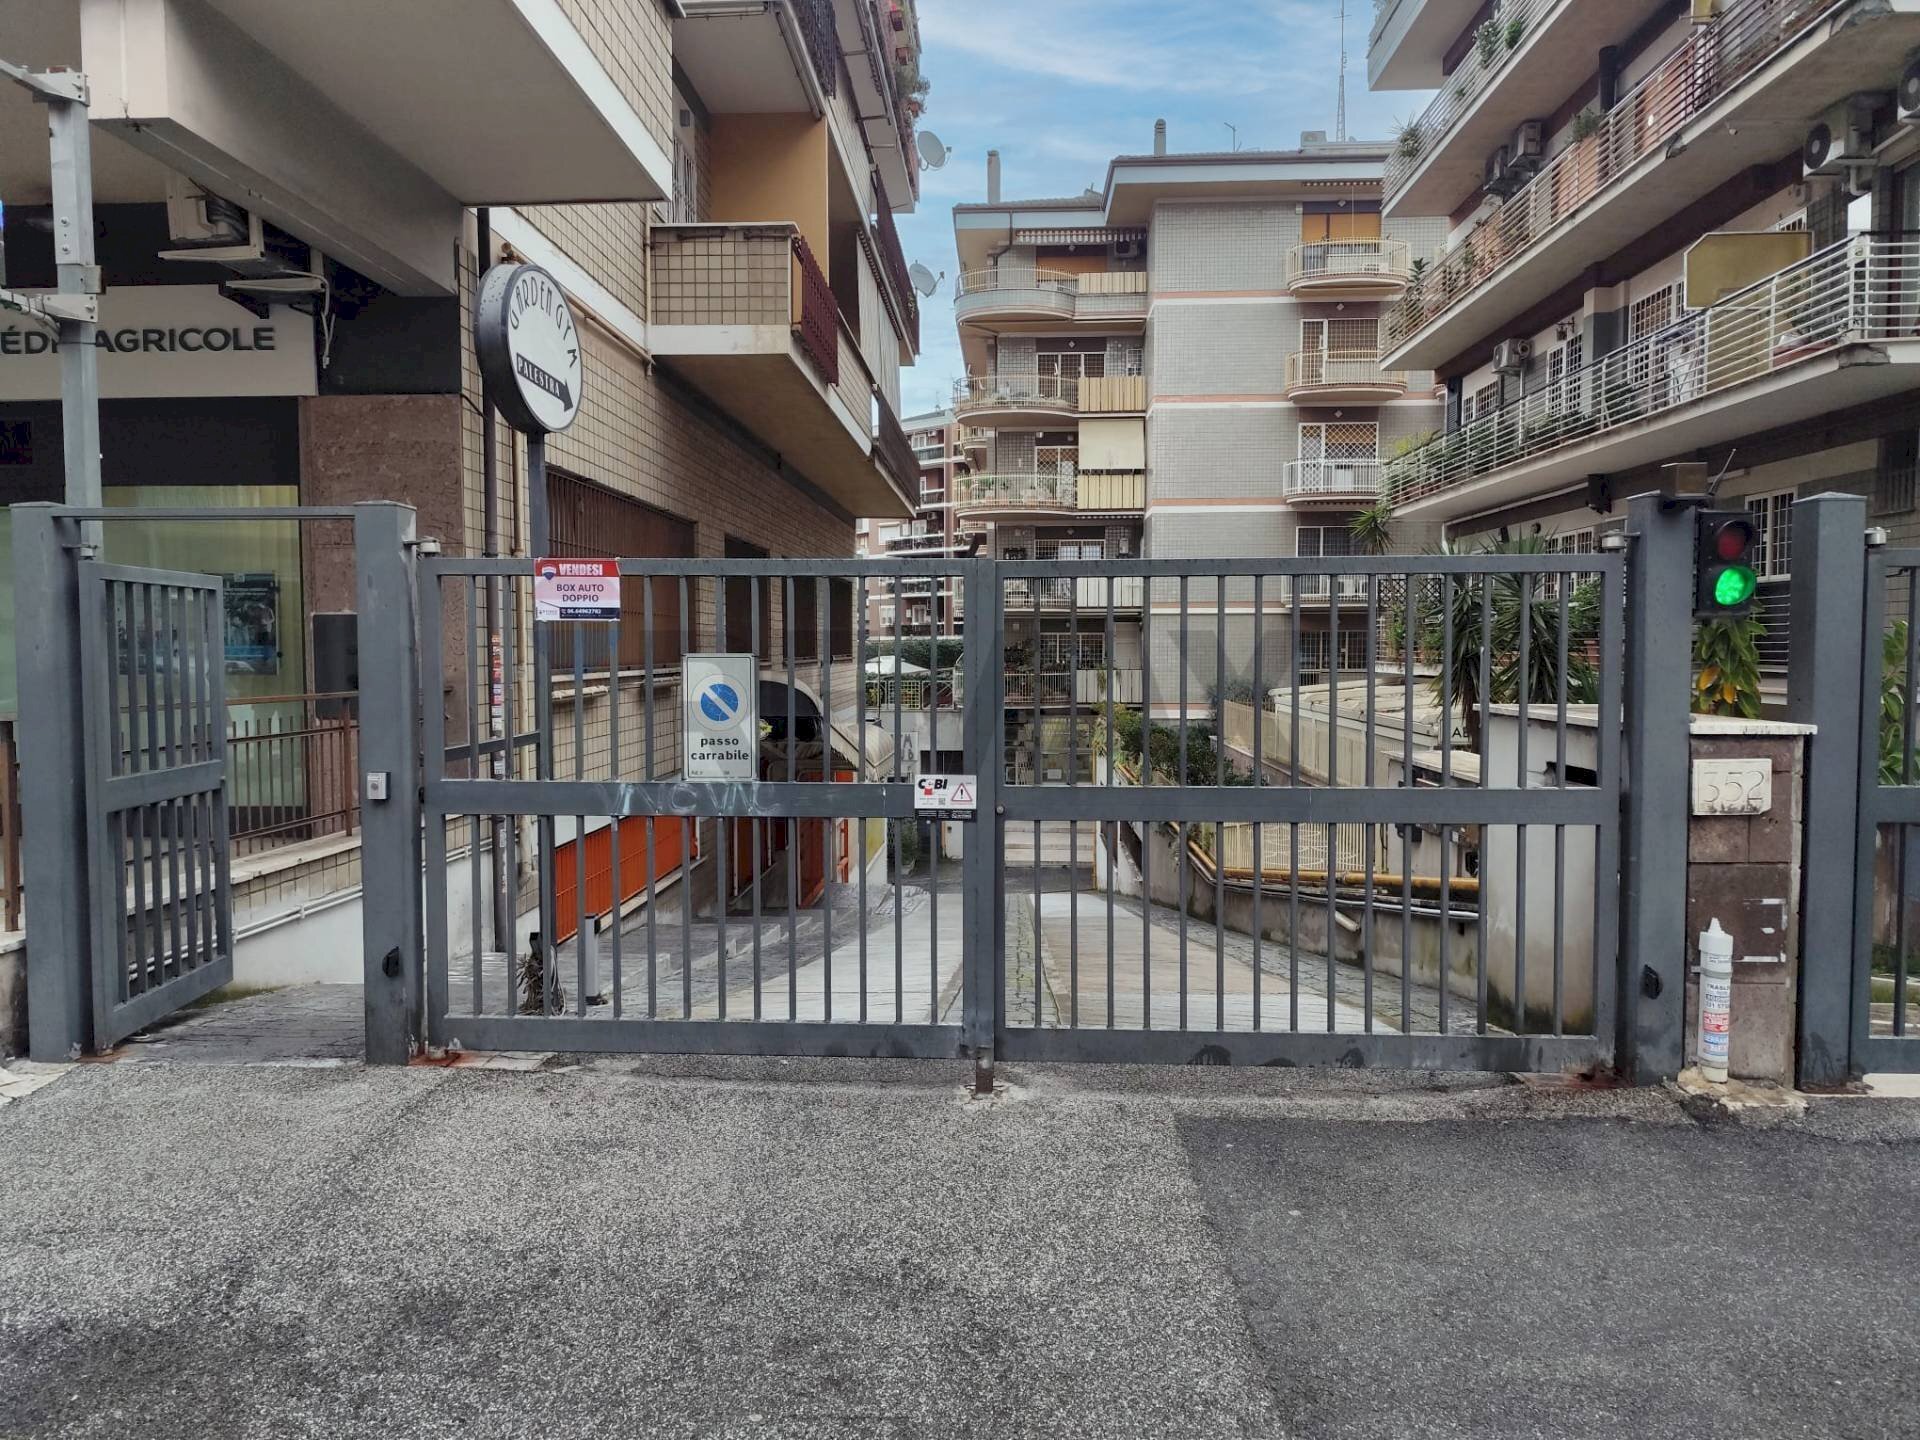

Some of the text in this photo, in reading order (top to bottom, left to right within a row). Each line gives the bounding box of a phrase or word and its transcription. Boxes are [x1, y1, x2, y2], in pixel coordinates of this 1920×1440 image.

[510, 276, 578, 369] GARDEN GYM
[95, 327, 276, 353] AGRICOLE
[517, 360, 561, 398] PALESTRA
[558, 563, 603, 576] VENDESI
[556, 583, 604, 592] BOX AUTO
[562, 594, 599, 602] DOPPIO
[700, 738, 740, 748] passo
[690, 750, 750, 760] carrabile
